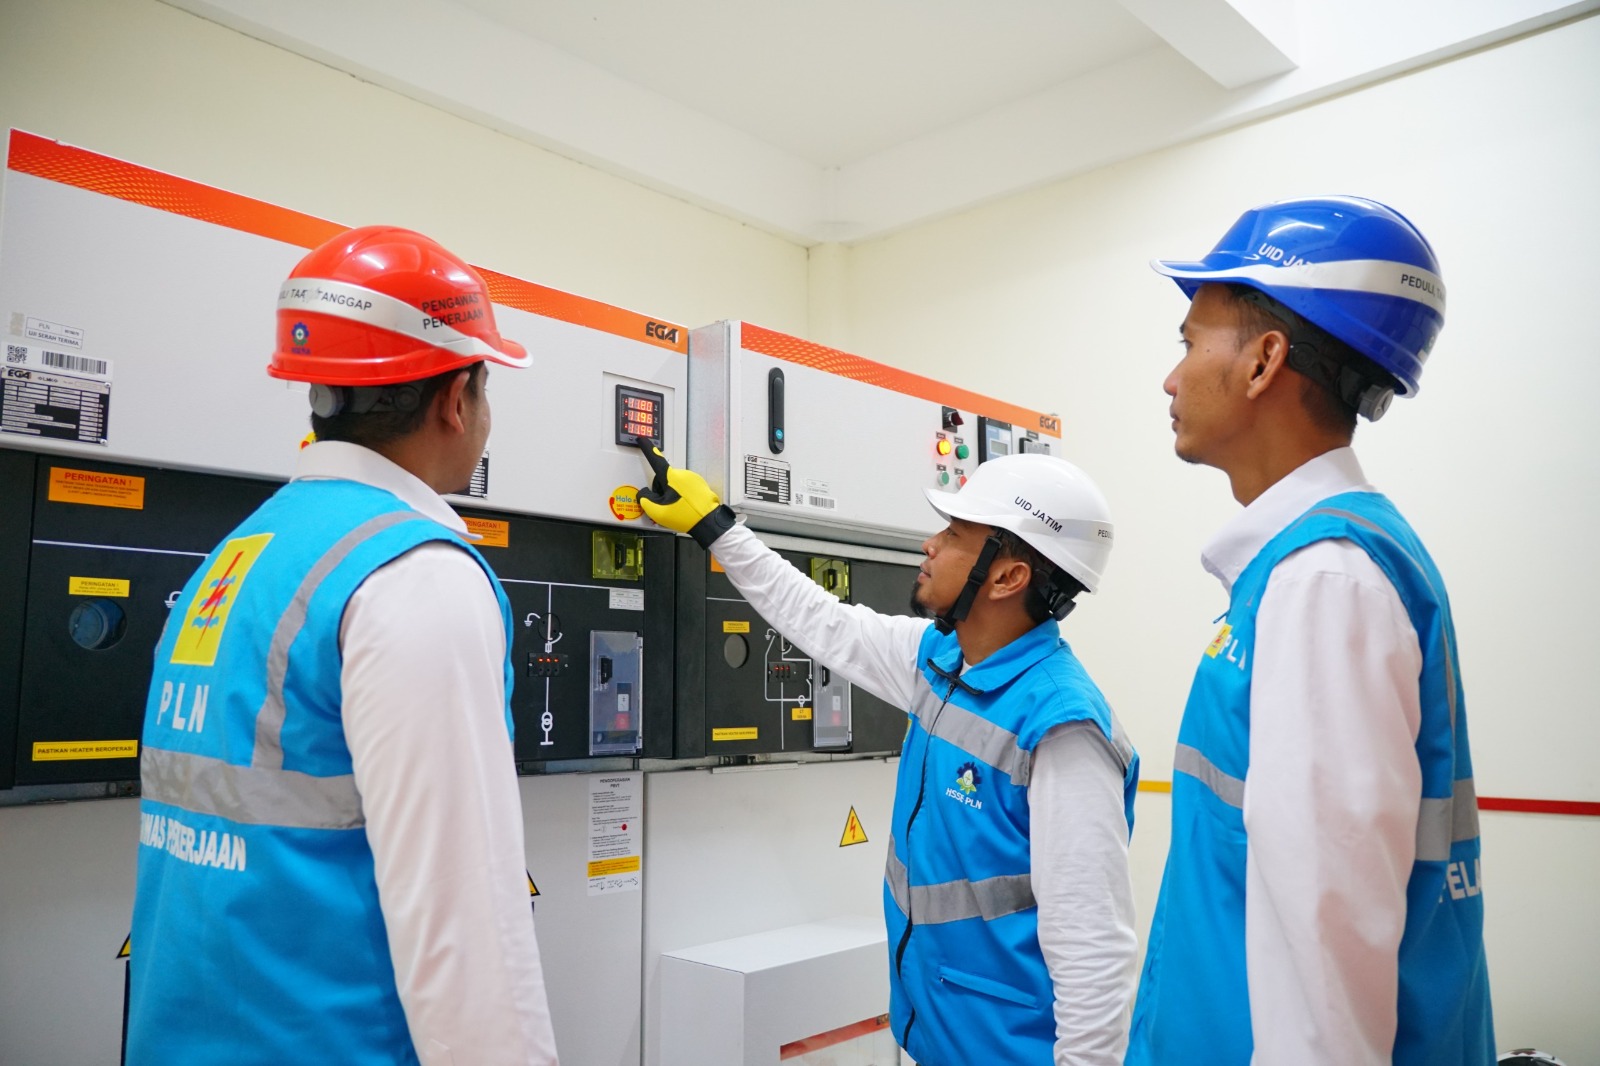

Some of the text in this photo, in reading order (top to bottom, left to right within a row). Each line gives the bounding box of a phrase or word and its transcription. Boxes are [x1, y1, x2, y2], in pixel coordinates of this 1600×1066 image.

[1258, 243, 1283, 261] UID
[421, 292, 479, 313] PENGAWAS
[422, 308, 484, 330] PEKERJAAN
[38, 332, 57, 341] SERAH
[58, 336, 80, 346] TERIMA
[645, 320, 679, 344] EGA
[7, 369, 31, 380] EGA
[1039, 415, 1058, 431] EGA
[64, 471, 127, 486] PERINGATAN
[1014, 496, 1063, 533] UID JATIM
[80, 580, 116, 588] PERINGATAN
[156, 680, 210, 734] PLN
[37, 747, 69, 755] PASTIKAN
[945, 787, 983, 810] HSSE PLN
